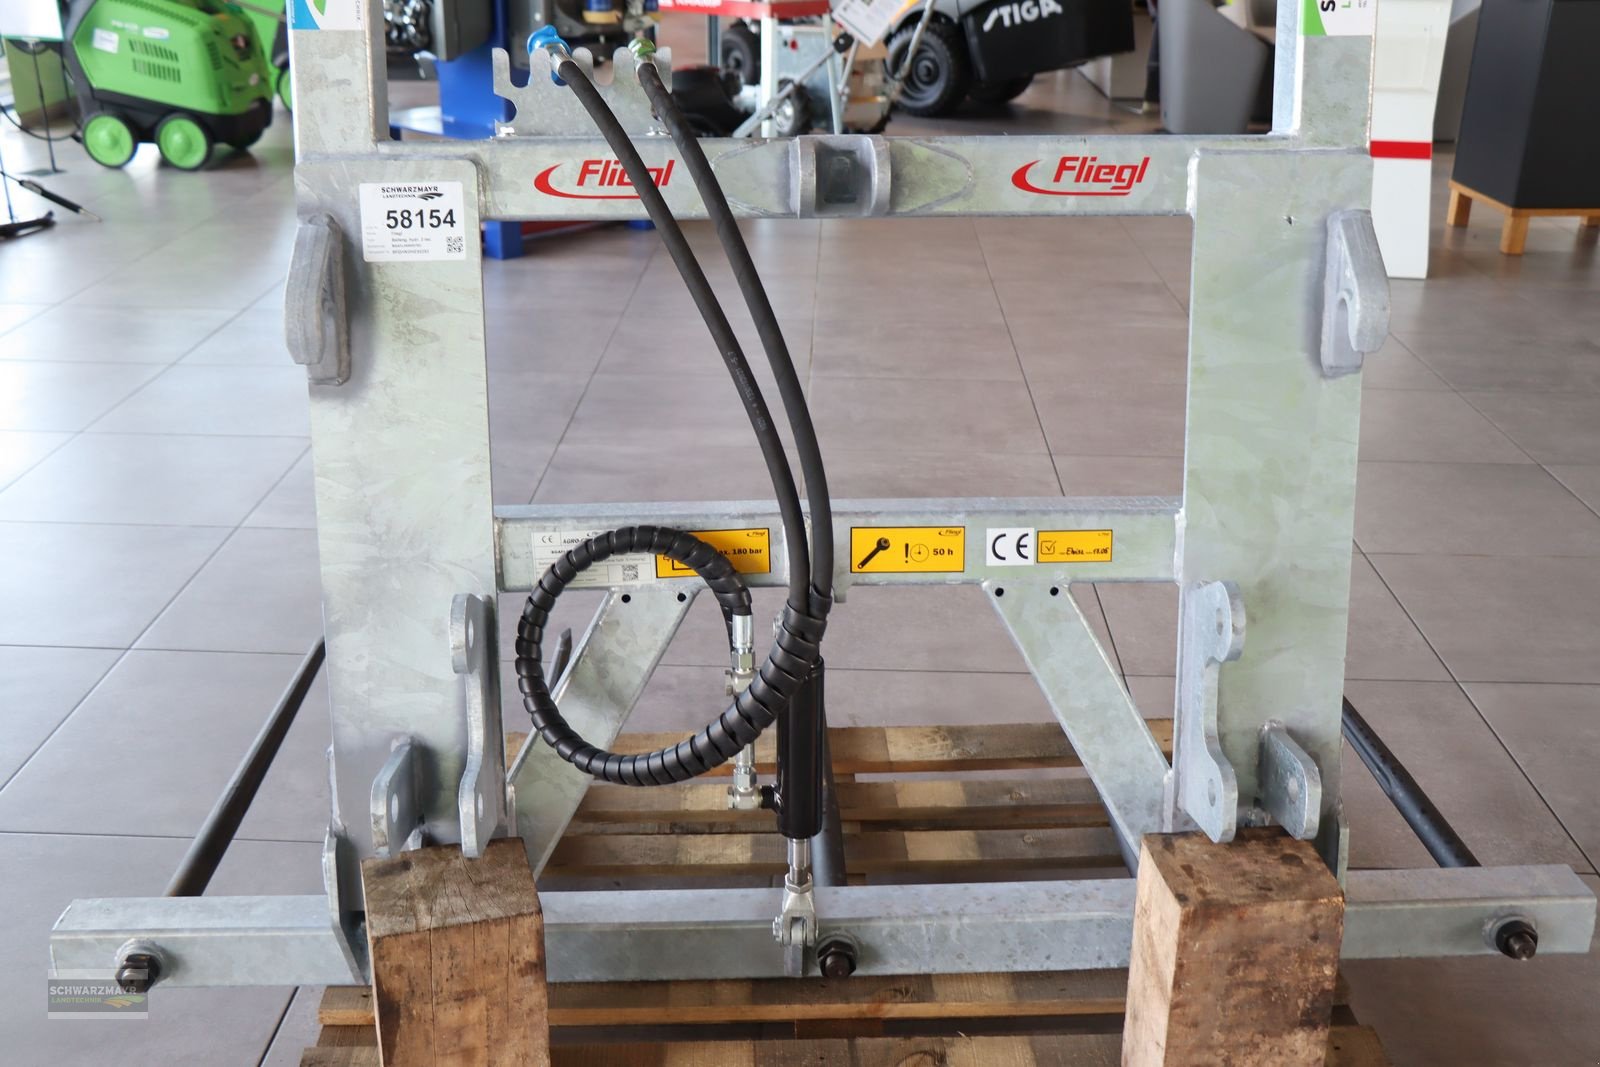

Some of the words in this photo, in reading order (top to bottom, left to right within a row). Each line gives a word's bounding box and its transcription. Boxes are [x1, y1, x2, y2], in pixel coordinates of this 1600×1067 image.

[983, 0, 1063, 32] STIGA
[1053, 156, 1150, 190] Fliegl
[386, 209, 457, 229] 58154
[933, 548, 945, 556] 50
[947, 548, 953, 556] h
[992, 533, 1029, 560] CE
